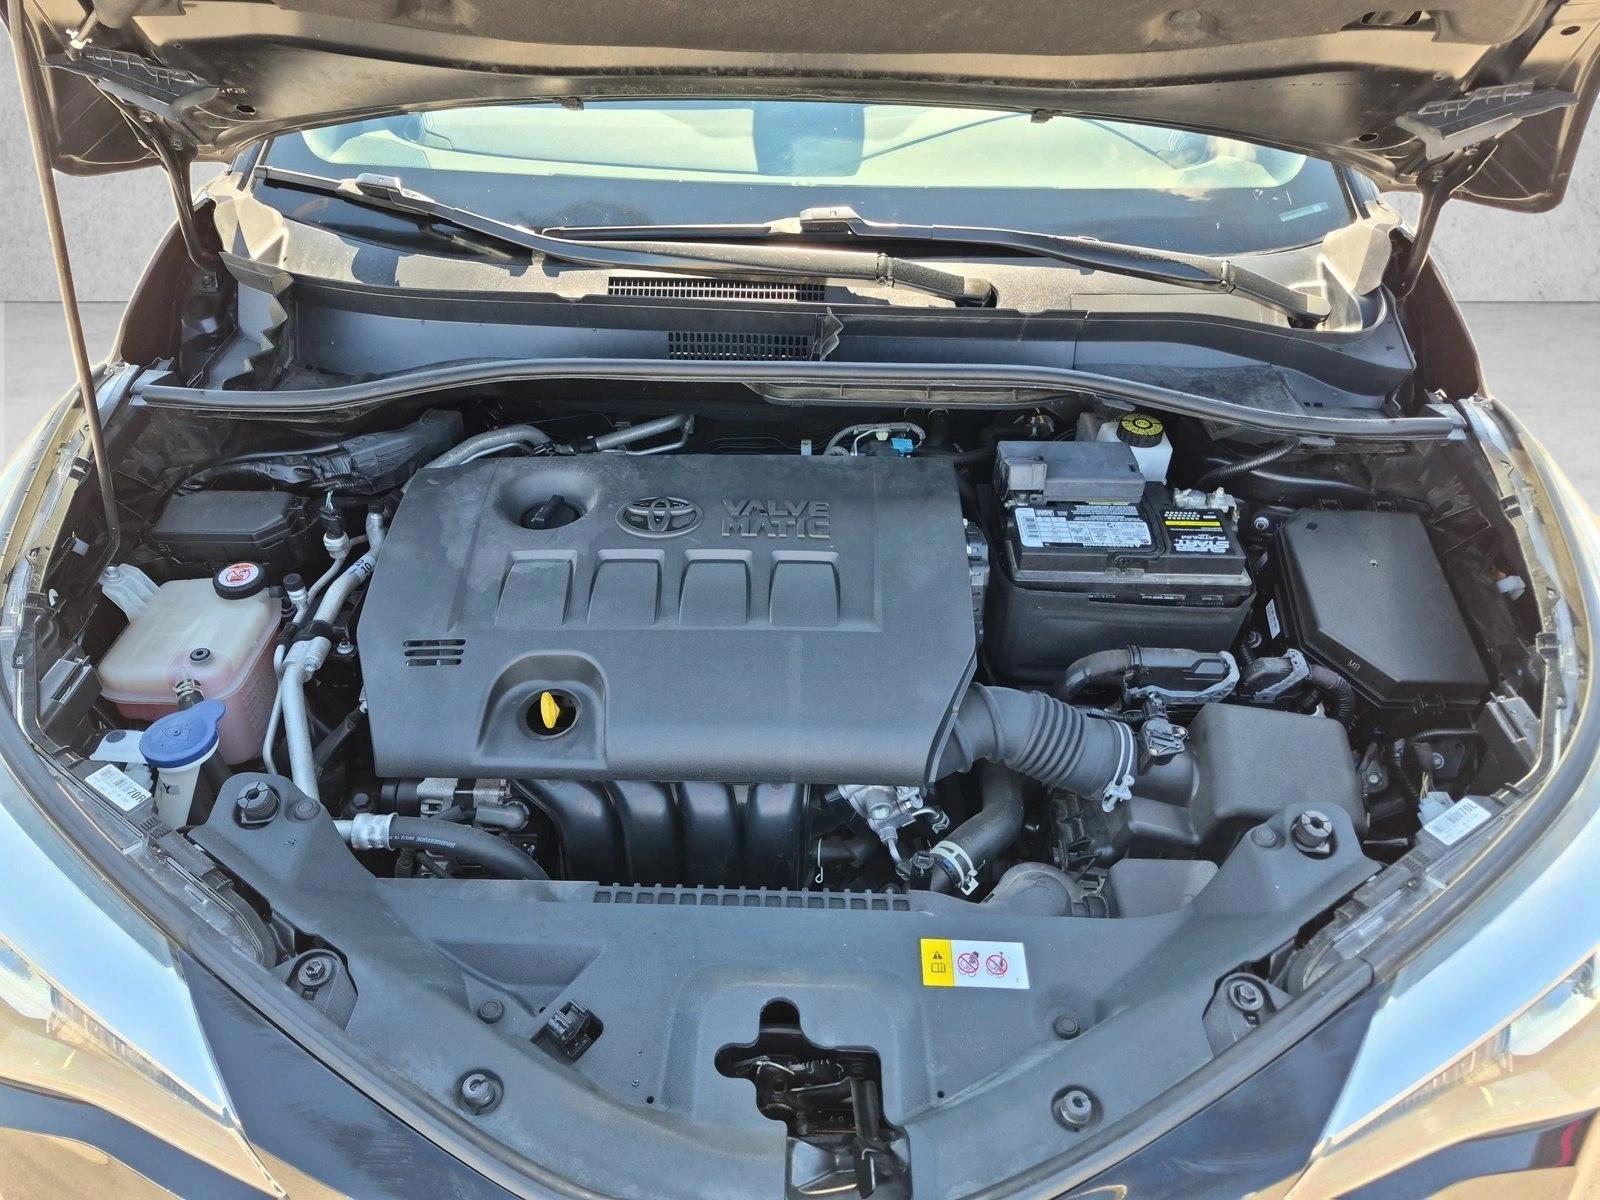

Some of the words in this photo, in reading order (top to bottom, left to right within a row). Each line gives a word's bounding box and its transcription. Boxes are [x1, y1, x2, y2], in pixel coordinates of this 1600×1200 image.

[721, 500, 830, 516] VALVE
[721, 517, 830, 538] MATIC
[127, 788, 147, 802] 70R
[1458, 803, 1478, 815] 70L
